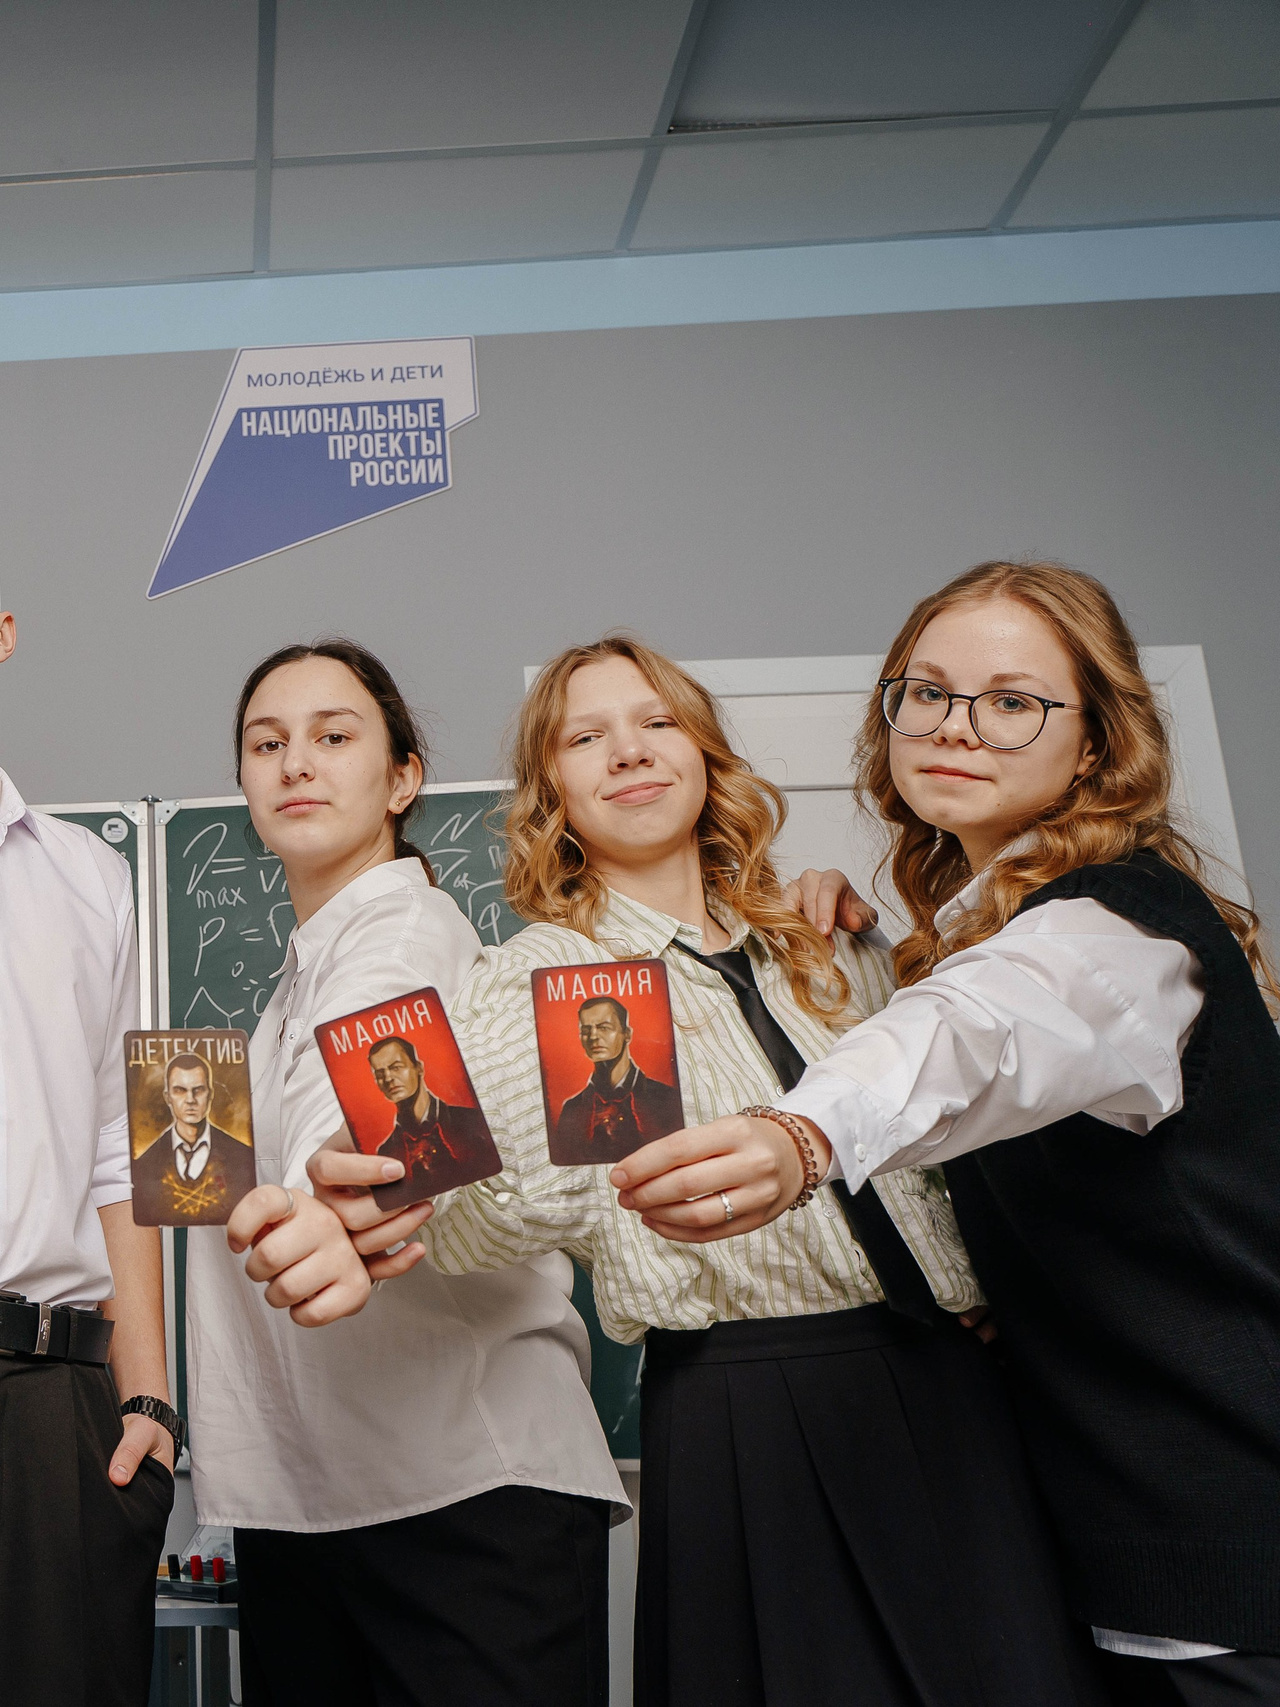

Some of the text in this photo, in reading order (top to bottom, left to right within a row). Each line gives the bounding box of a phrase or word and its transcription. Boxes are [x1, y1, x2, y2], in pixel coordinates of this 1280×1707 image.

[246, 364, 444, 388] МОЛОДЁЖЬ И ДЕТИ
[241, 401, 441, 438] НАЦИОНАЛЬНЫЕ
[328, 430, 443, 460] ПРОЕКТЫ
[350, 457, 445, 487] РОССИИ
[546, 967, 653, 1003] МАФИЯ
[328, 998, 433, 1056] МАФИЯ
[128, 1037, 246, 1068] ДЕТЕКТИВ
